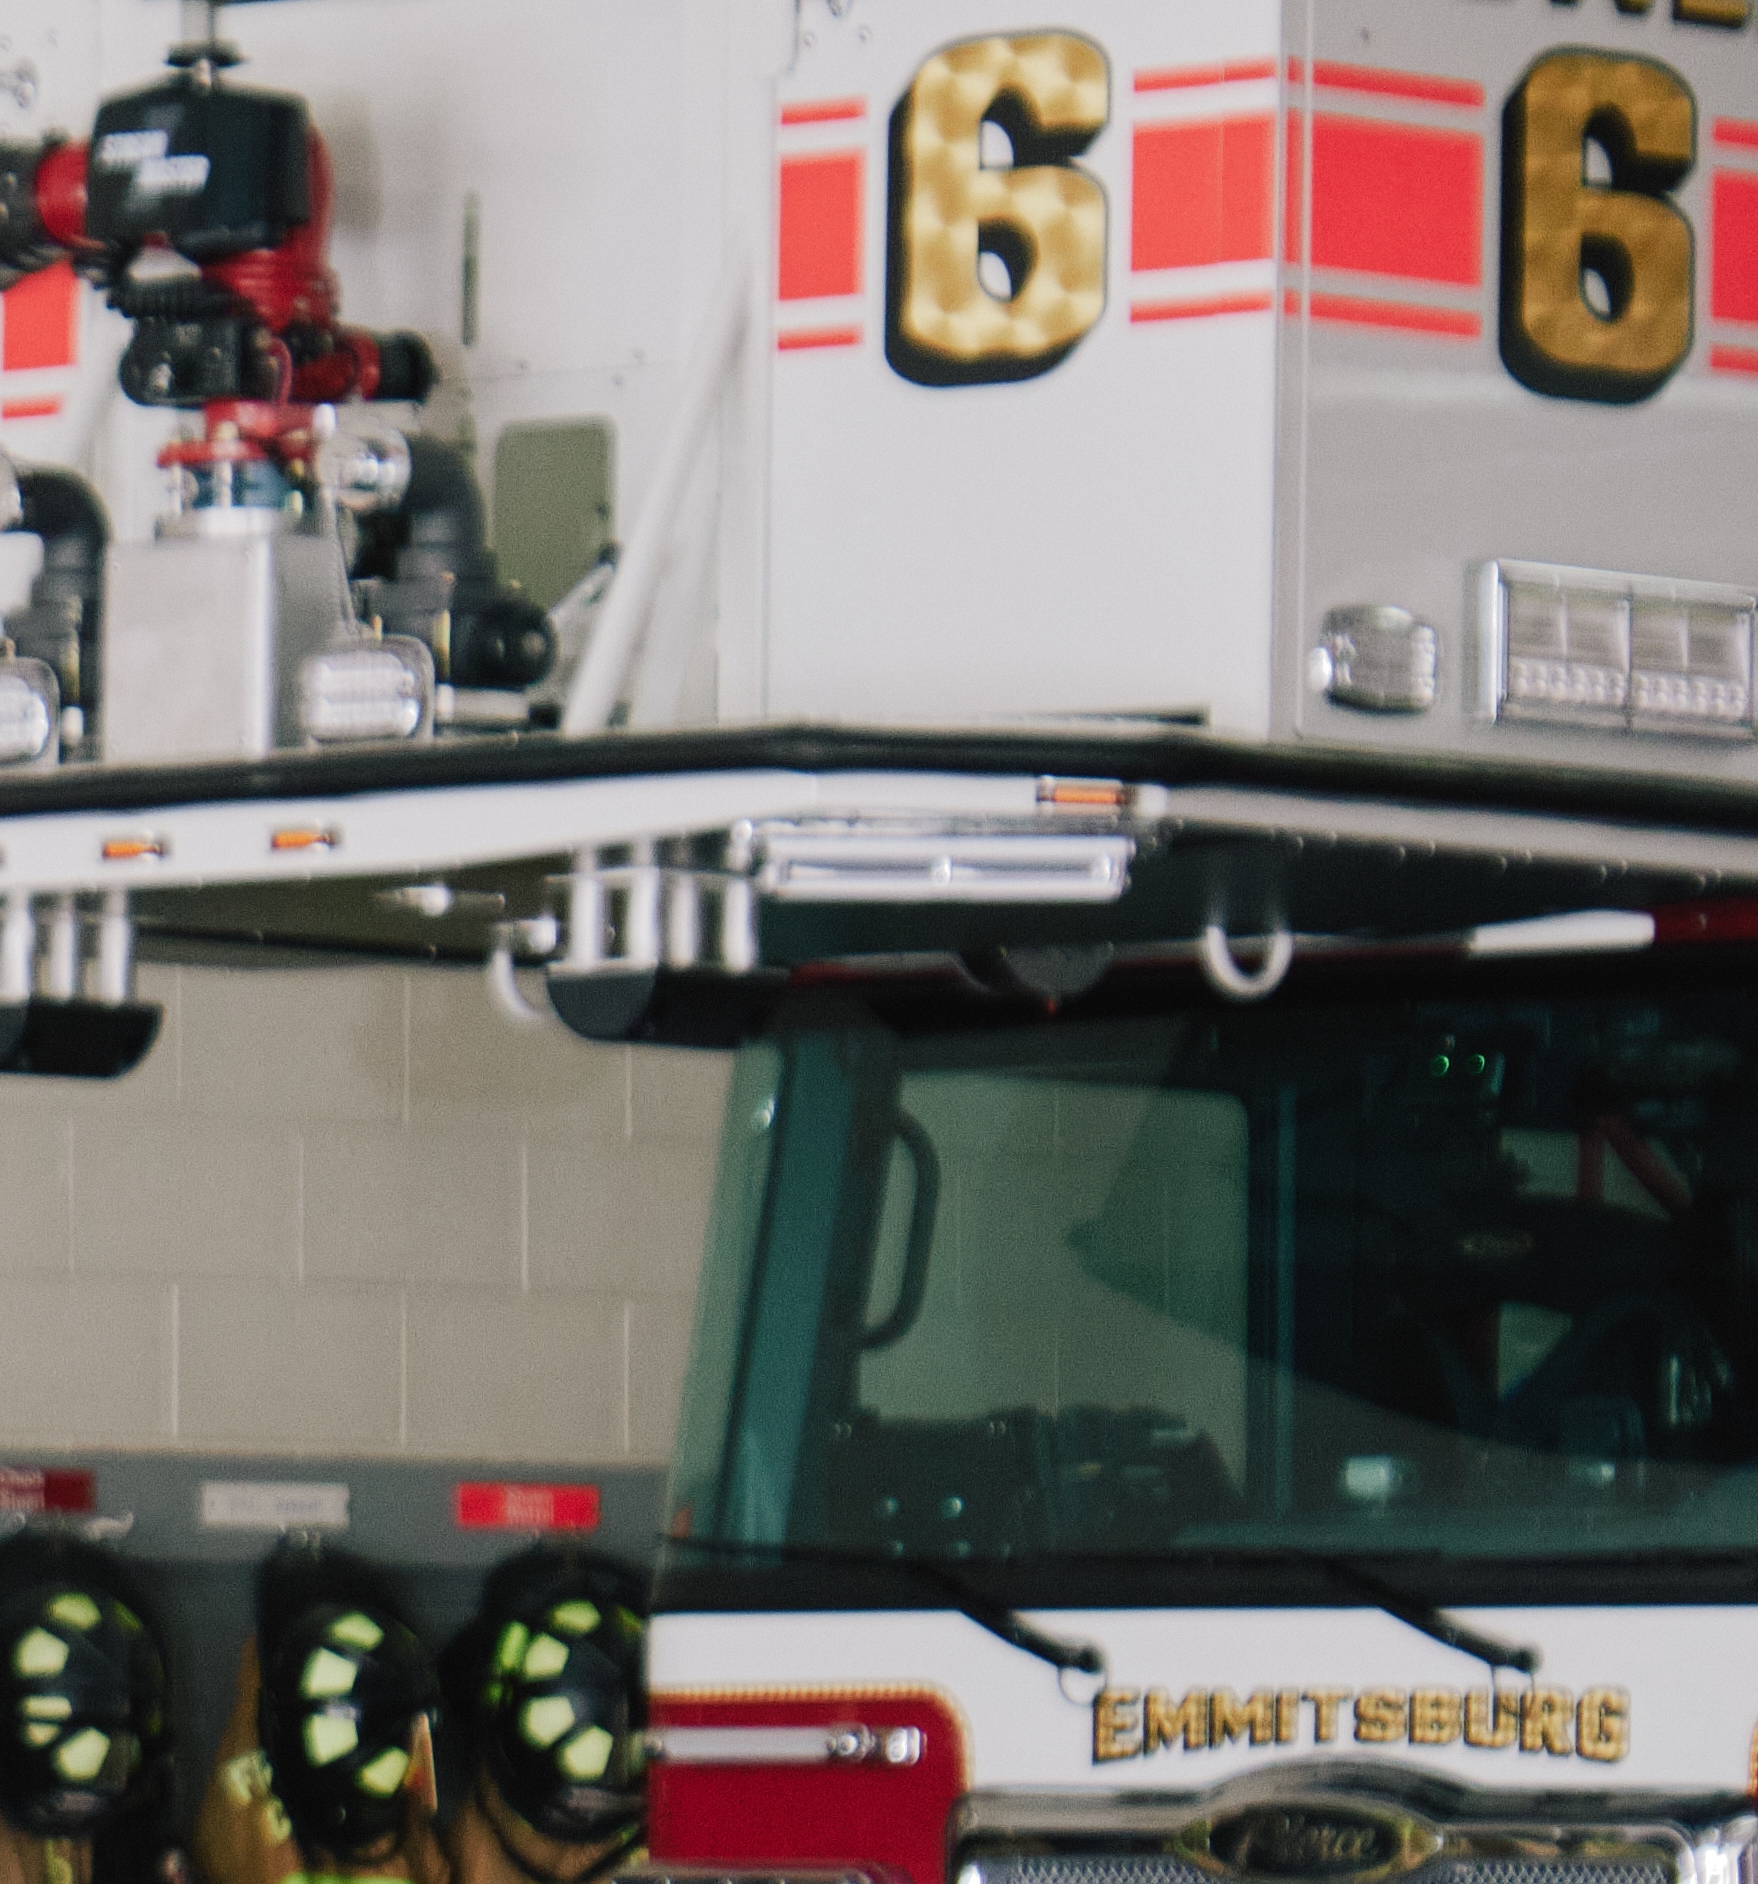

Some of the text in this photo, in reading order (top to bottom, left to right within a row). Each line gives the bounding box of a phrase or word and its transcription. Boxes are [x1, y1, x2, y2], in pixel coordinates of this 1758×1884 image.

[885, 28, 1110, 387] 6
[1500, 43, 1699, 404] 6
[1091, 1685, 1630, 1764] EMMITSBURG
